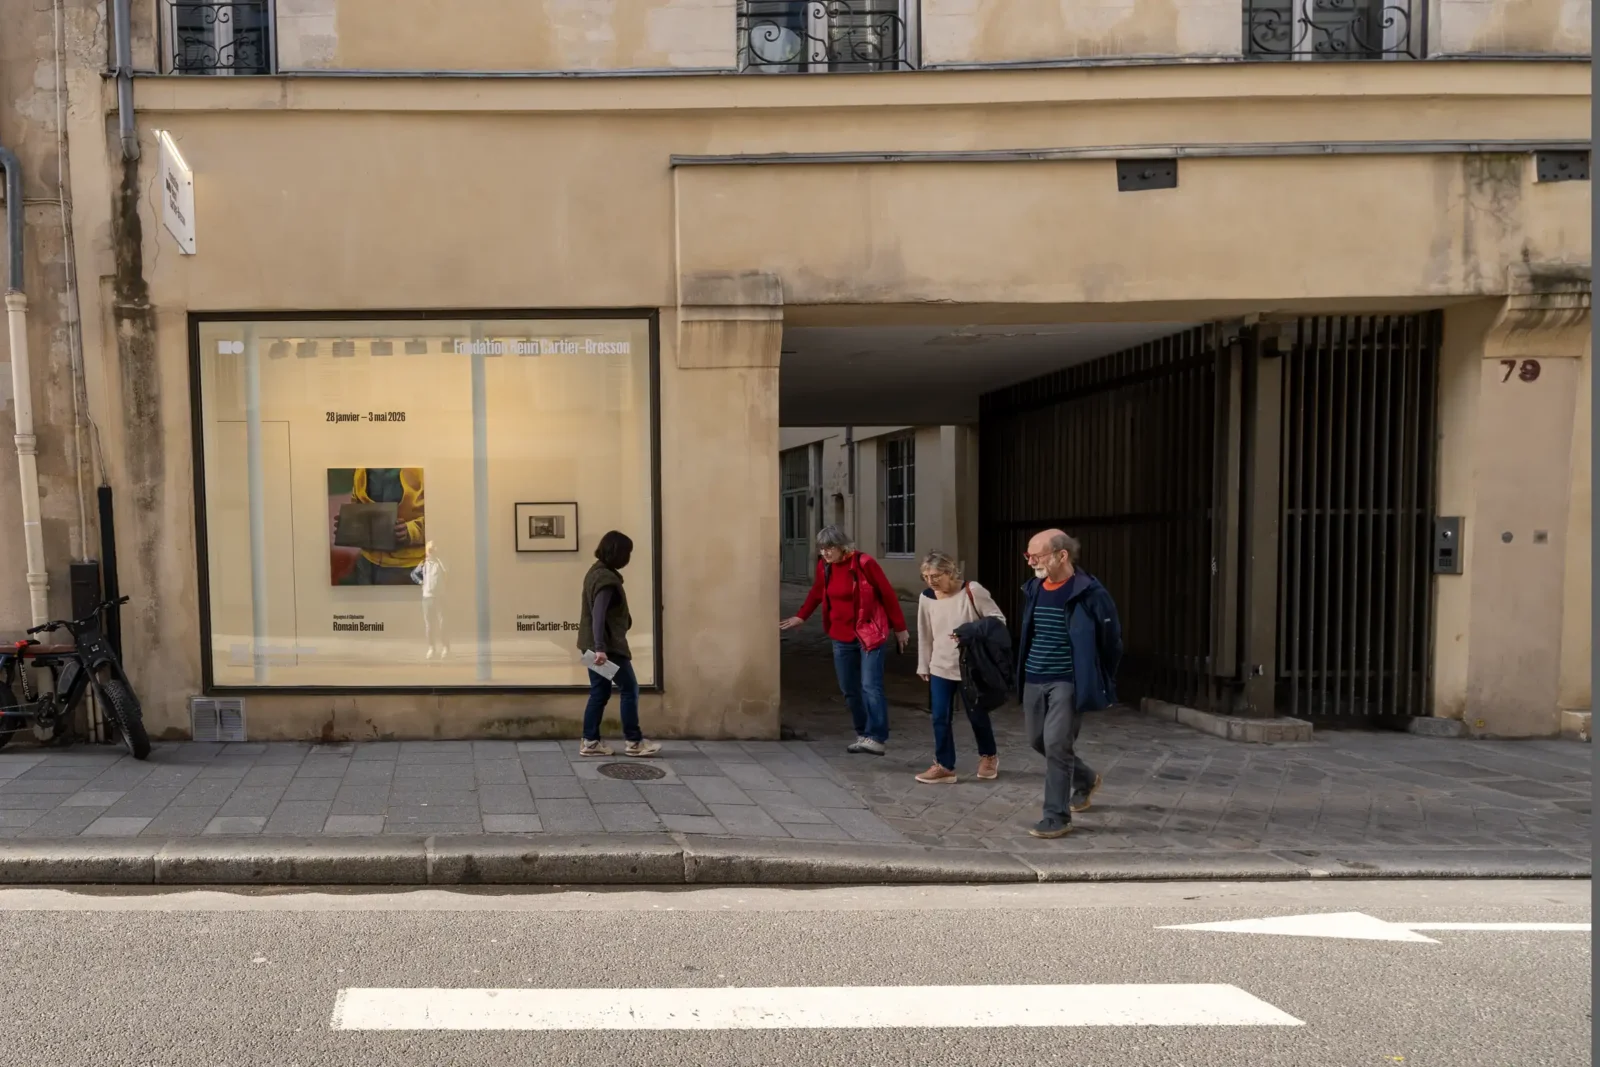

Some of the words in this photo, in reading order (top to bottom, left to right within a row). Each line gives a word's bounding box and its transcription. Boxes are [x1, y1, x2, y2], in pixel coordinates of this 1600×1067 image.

[454, 339, 509, 355] Fondation
[510, 338, 539, 355] Henri
[540, 338, 630, 355] Cartier-Bresson
[1500, 359, 1541, 383] 79
[326, 411, 336, 422] 28
[335, 411, 360, 424] janvier
[368, 411, 374, 422] 3
[374, 411, 388, 422] mai
[388, 411, 406, 422] 2026
[333, 621, 359, 632] Romain
[359, 621, 384, 632] Bernini
[516, 621, 536, 632] Henri
[536, 620, 581, 632] Cartier-Bres
